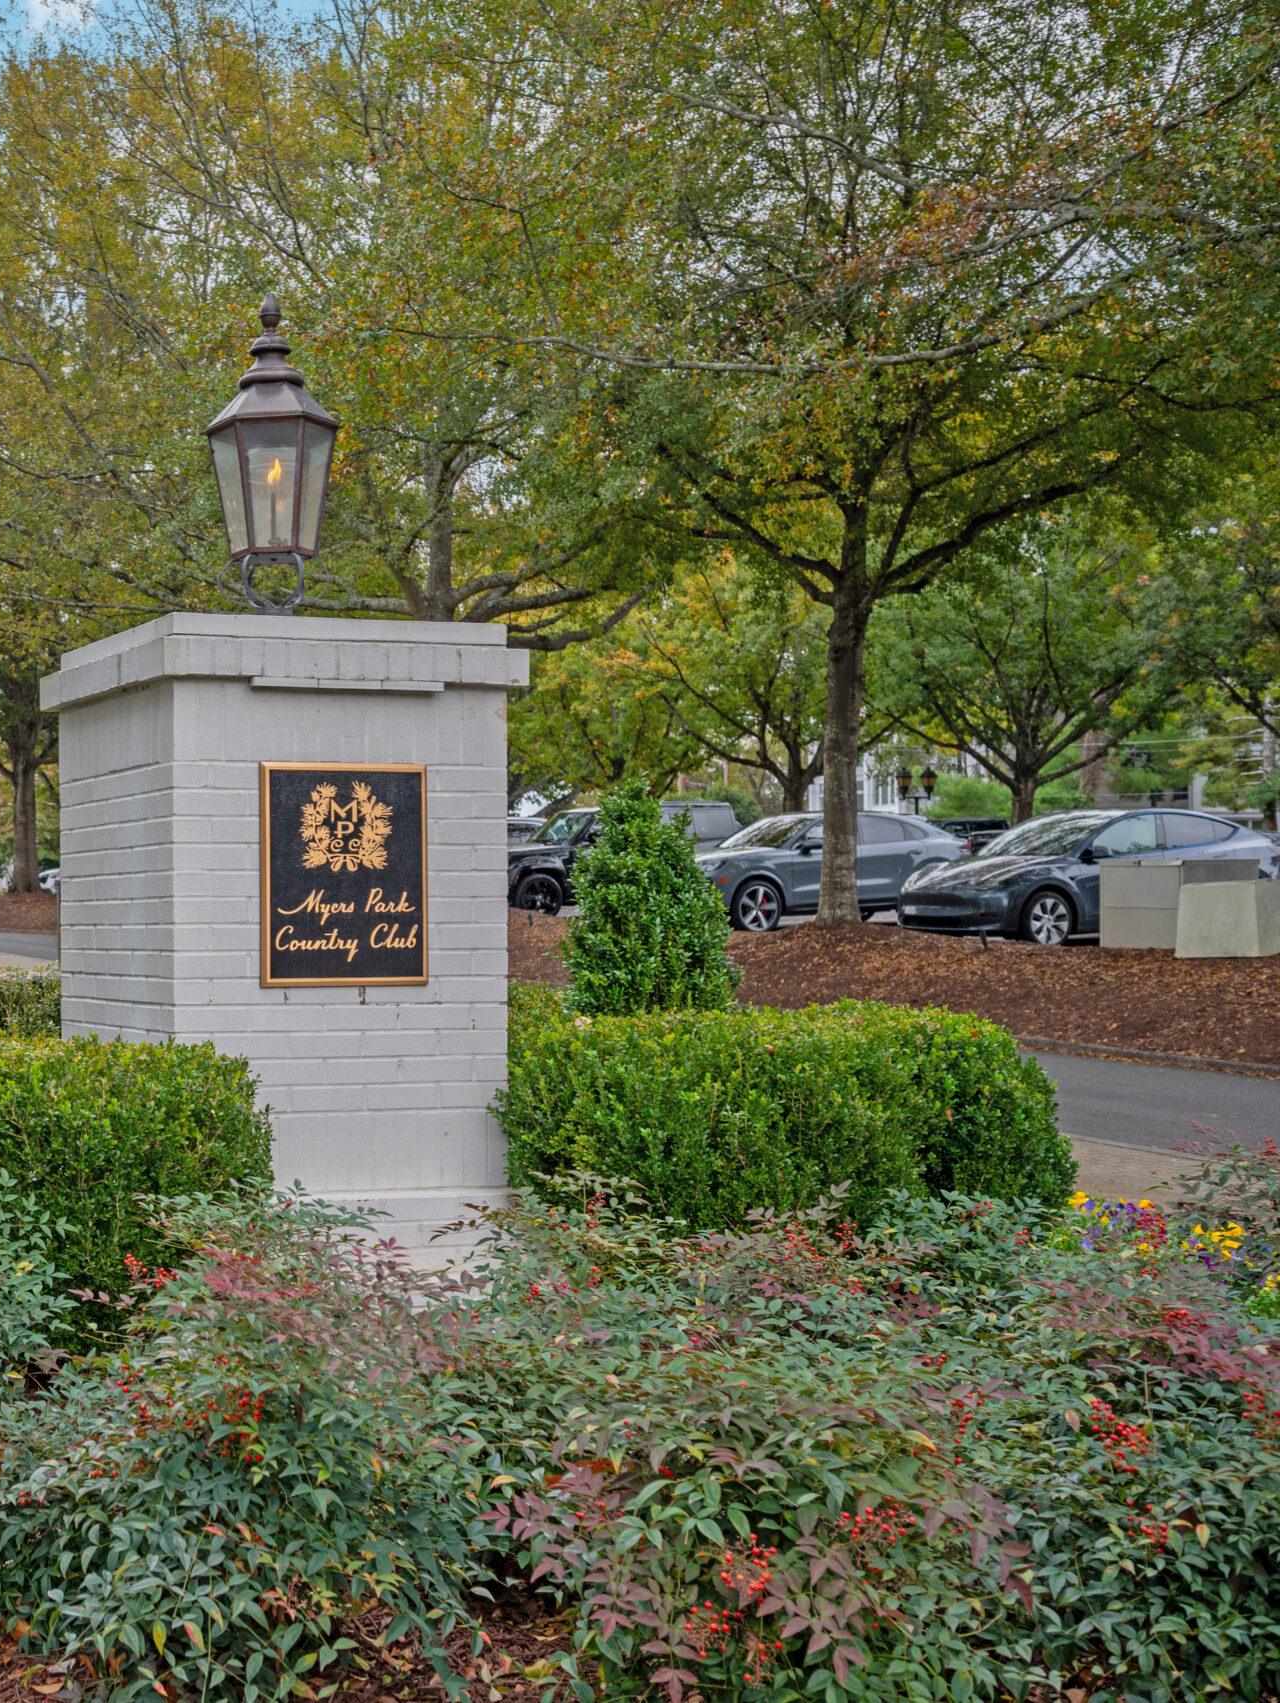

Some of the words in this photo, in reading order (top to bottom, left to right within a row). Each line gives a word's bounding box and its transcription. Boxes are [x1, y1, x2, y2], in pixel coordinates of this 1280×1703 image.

[331, 799, 357, 822] M
[335, 821, 354, 838] P
[277, 889, 355, 926] Myers
[365, 887, 416, 914] Park
[275, 925, 359, 962] Country
[370, 922, 418, 949] Club
